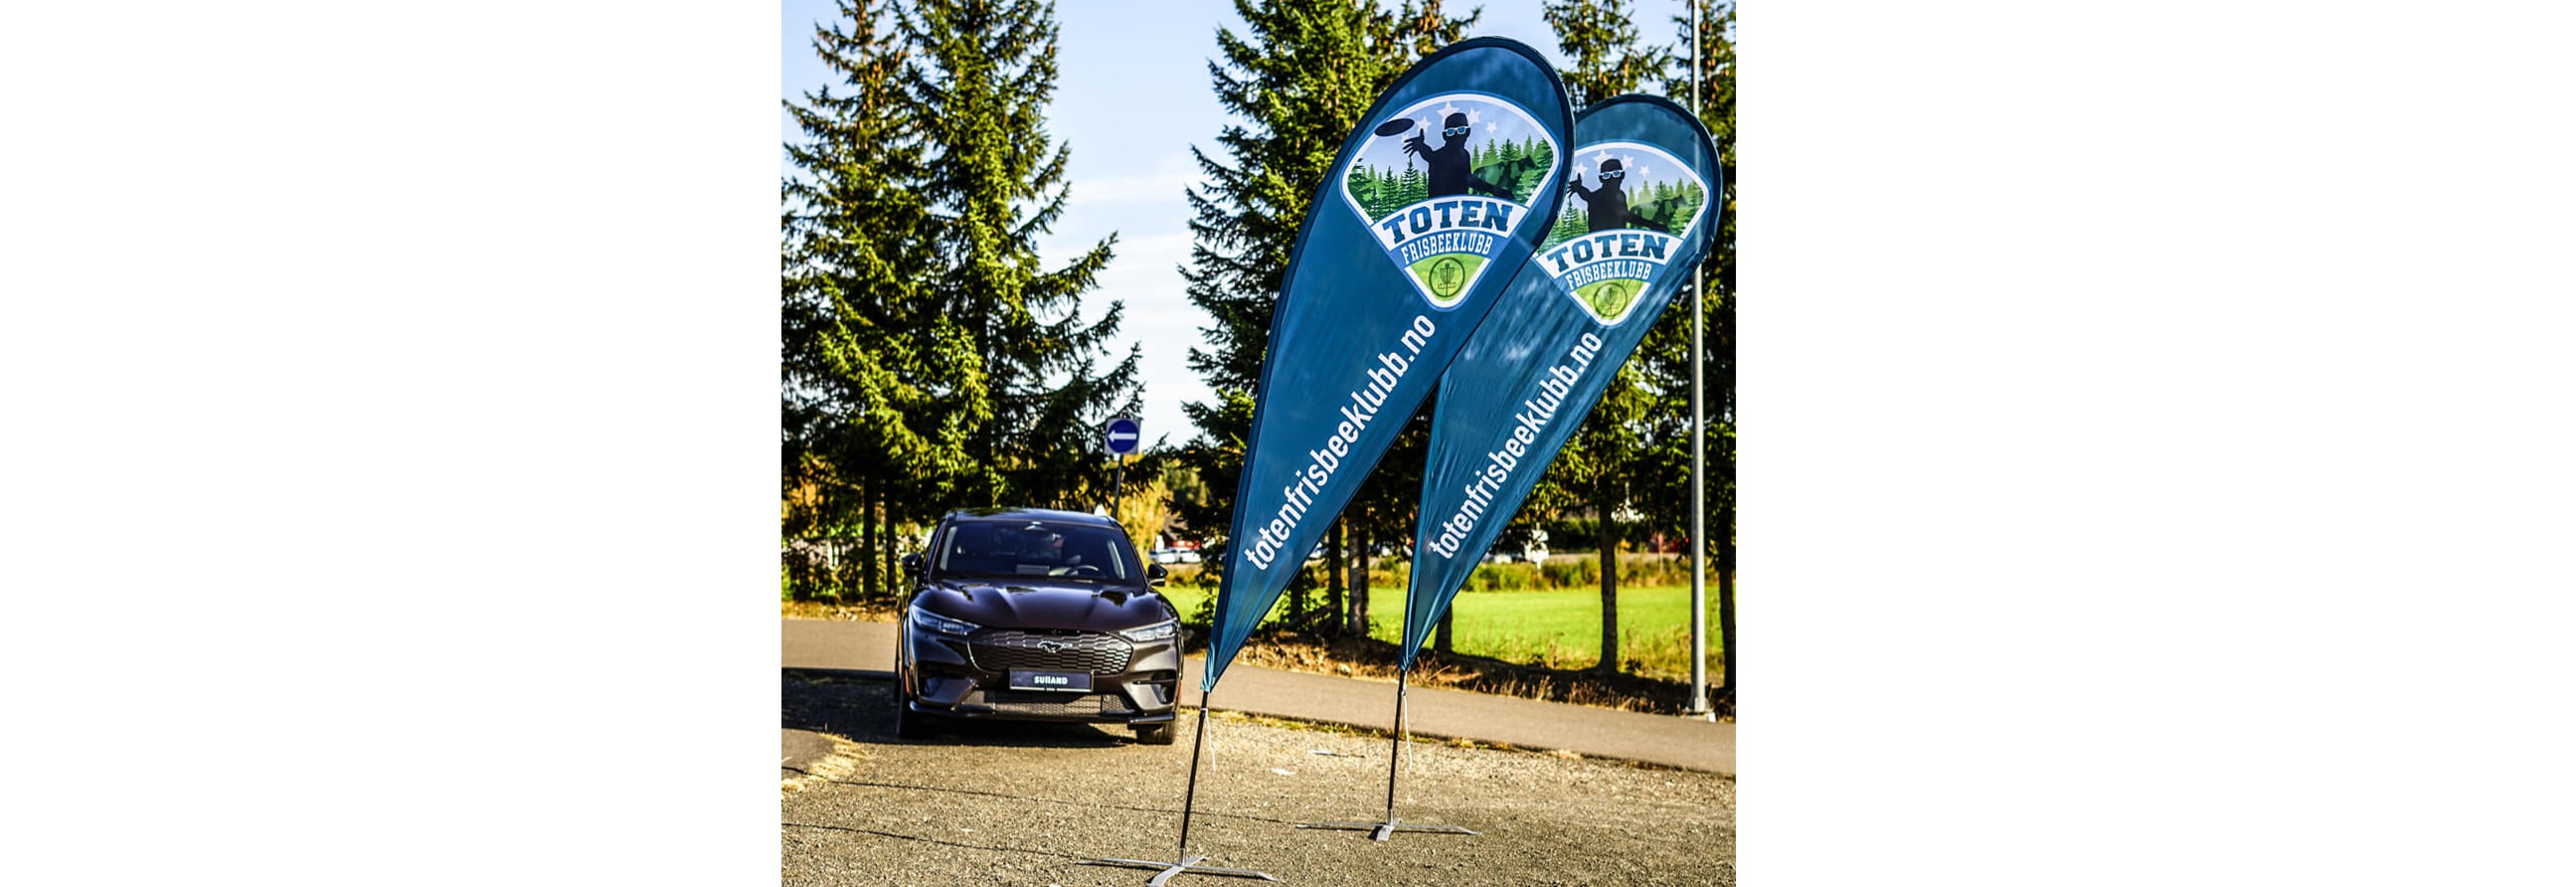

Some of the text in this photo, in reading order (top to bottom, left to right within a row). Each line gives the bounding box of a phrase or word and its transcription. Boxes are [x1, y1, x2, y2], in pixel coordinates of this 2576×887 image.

[1382, 200, 1513, 245] TOTEN
[1400, 232, 1493, 266] FRISBEEKLUBB
[1546, 234, 1670, 272] TOTEN
[1565, 261, 1651, 290] FRISBEEKLUBB
[1245, 313, 1436, 572] totenfrisbeeklubb.no
[1428, 331, 1603, 560] totenfrisbeeklubb.no
